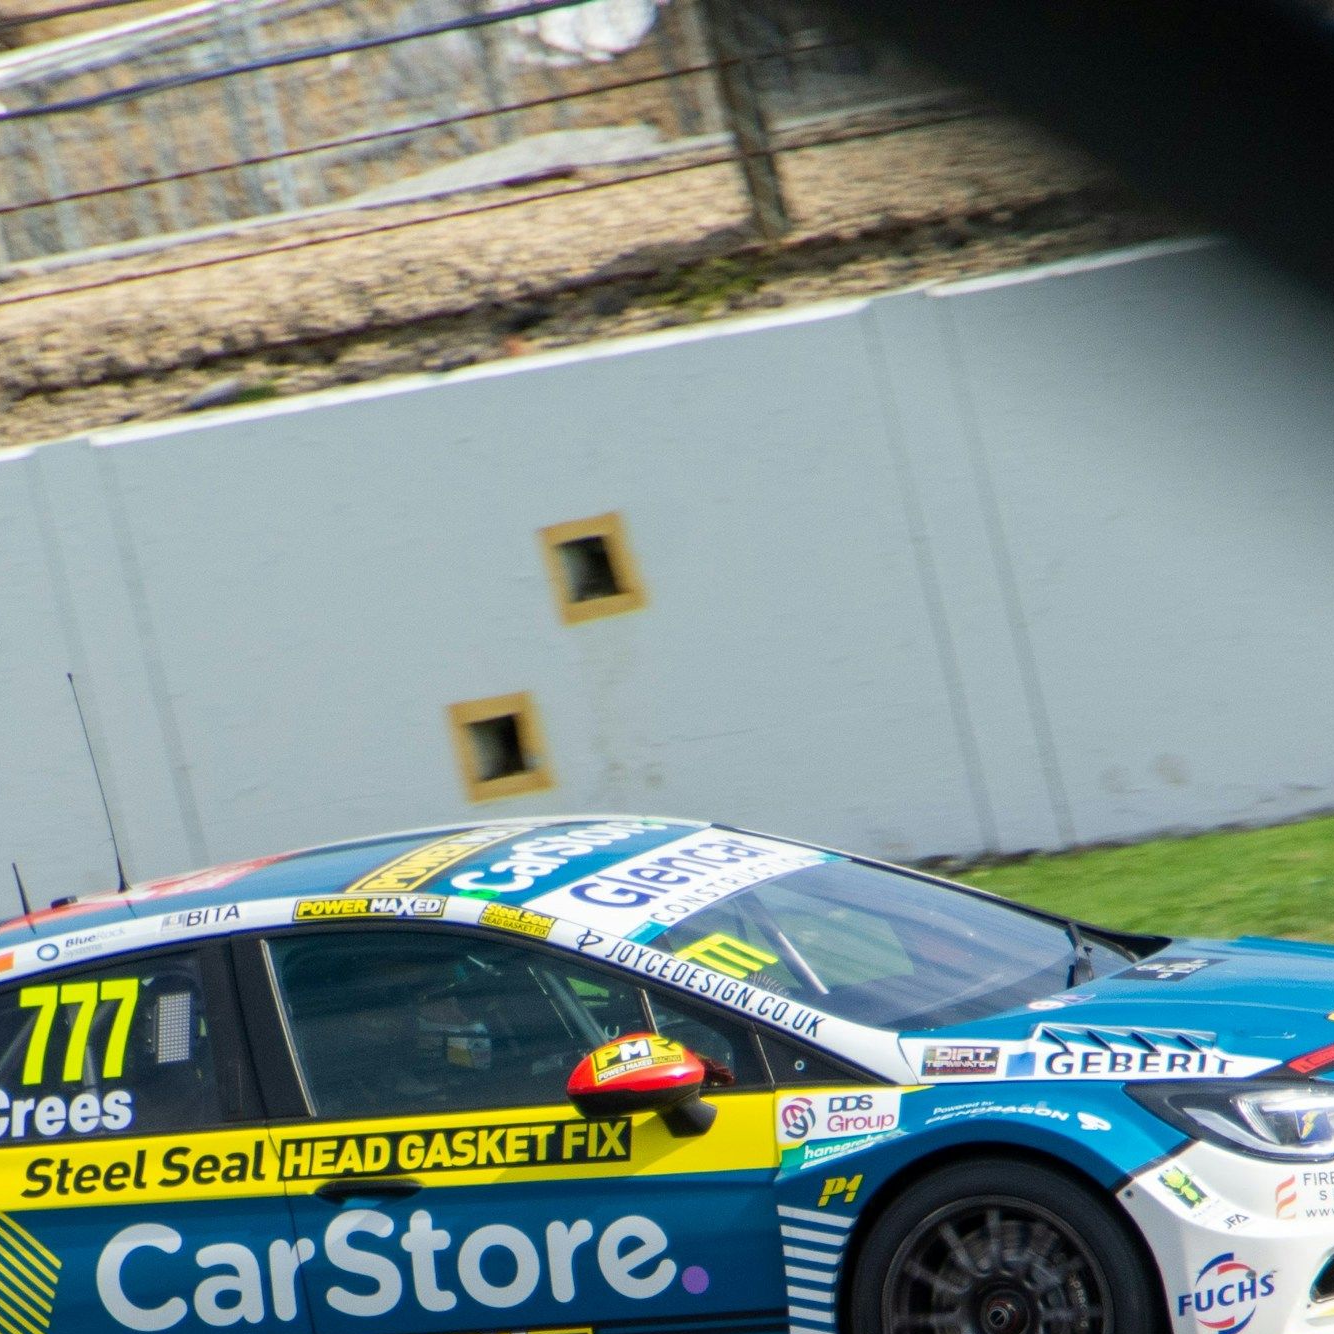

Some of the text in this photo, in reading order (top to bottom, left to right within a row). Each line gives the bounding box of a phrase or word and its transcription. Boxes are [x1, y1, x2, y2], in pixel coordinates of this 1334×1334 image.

[570, 838, 776, 908] Glencar
[186, 904, 241, 928] BITA
[298, 896, 442, 917] POWER MAXED
[481, 915, 547, 937] HEAD GASKET FIX
[606, 940, 827, 1038] JOYCEDESIGN.CO.UK
[20, 979, 138, 1085] 777
[936, 1048, 992, 1061] DIRT
[1046, 1050, 1234, 1076] GEBERIT
[828, 1095, 873, 1113] DDS
[932, 1102, 978, 1115] Powered
[827, 1113, 895, 1132] Group
[20, 1122, 627, 1198] Steel Seal HEAD GASKET FIX
[1178, 1274, 1275, 1317] FUCHS
